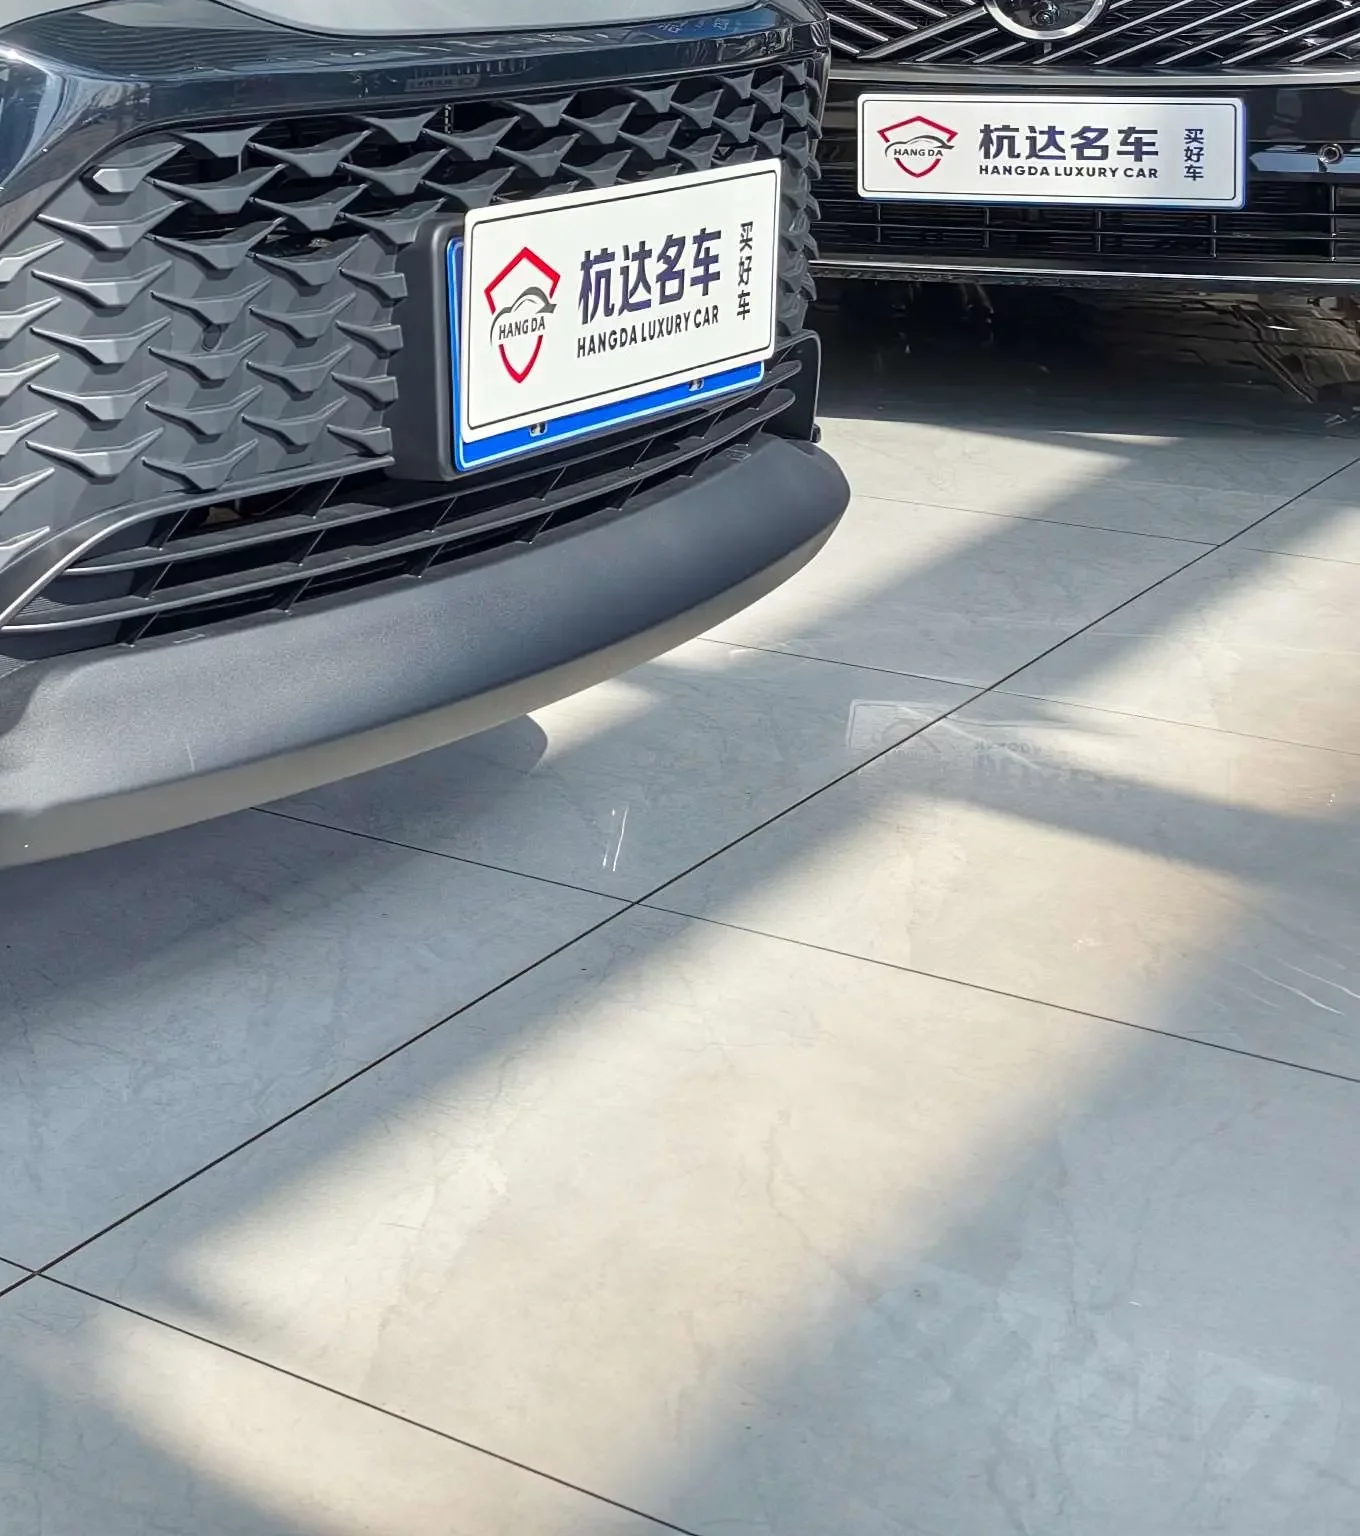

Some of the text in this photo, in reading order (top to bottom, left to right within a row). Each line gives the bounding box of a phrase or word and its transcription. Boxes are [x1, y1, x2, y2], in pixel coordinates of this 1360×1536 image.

[893, 148, 944, 157] HANG DA
[978, 123, 1159, 163] 杭达名车
[1183, 127, 1205, 182] 买好车
[978, 165, 1159, 179] HANGDA LUXURY CAR
[577, 226, 722, 326] 杭达名车
[735, 220, 755, 322] 买好车
[498, 316, 546, 341] HANG DA
[576, 305, 720, 359] HANGDA LUXURY CAR
